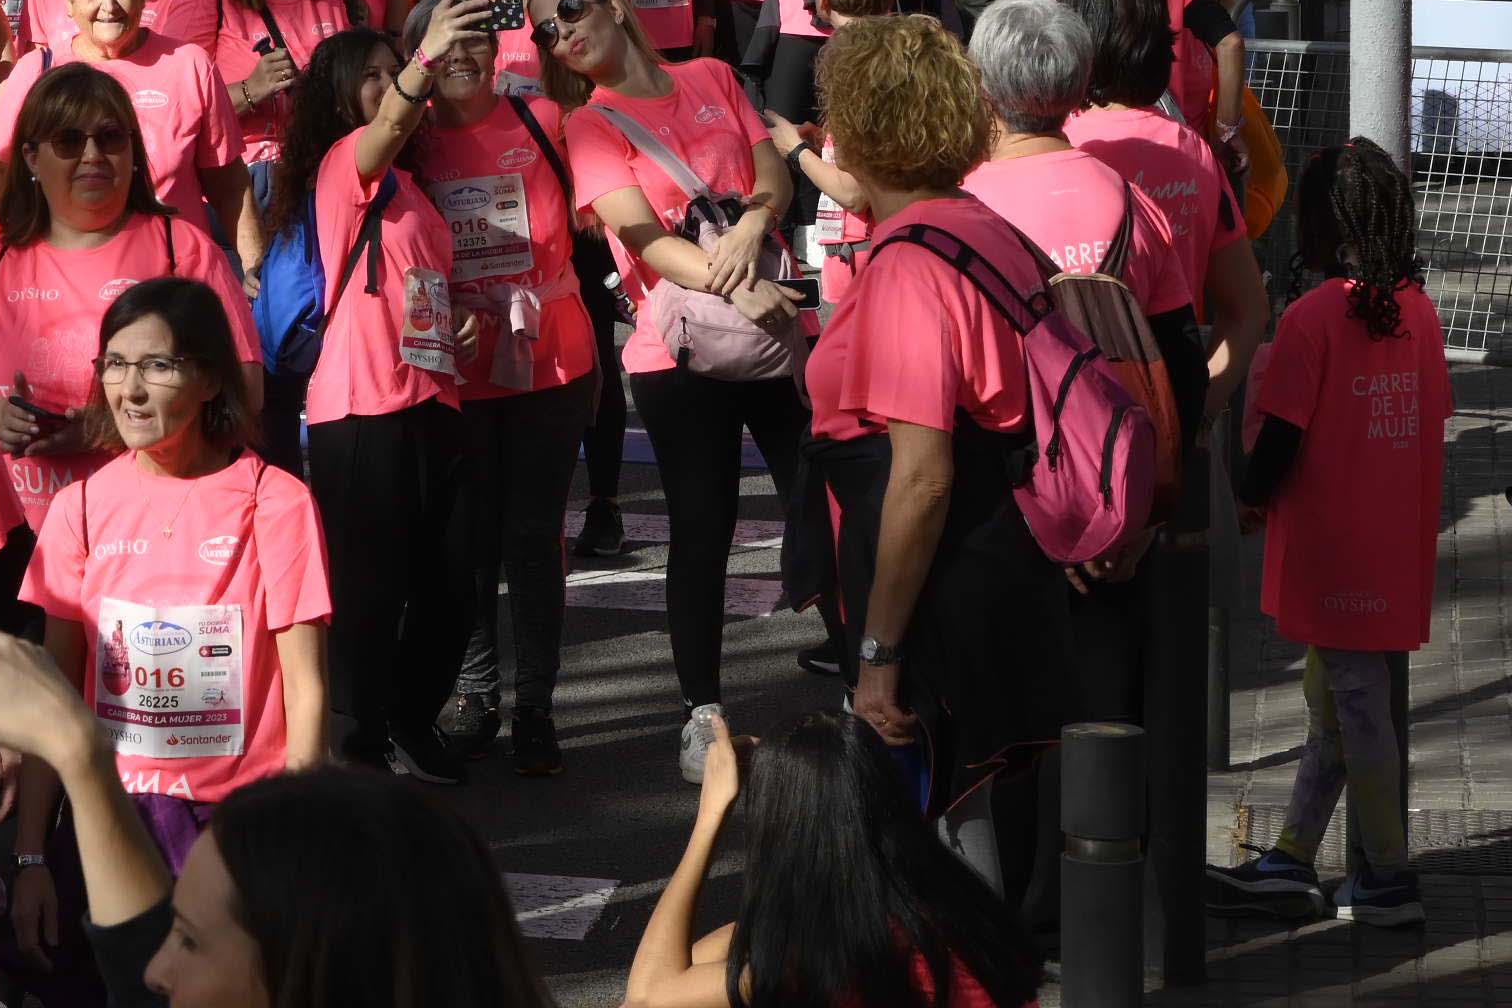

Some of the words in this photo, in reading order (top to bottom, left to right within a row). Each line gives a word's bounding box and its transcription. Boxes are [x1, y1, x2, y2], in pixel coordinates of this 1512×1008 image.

[451, 218, 489, 235] 016
[457, 236, 487, 248] 12375
[8, 288, 60, 303] OYSHO
[1371, 396, 1395, 416] DE
[1368, 416, 1418, 440] MUJE
[199, 626, 230, 635] SUMA
[134, 632, 187, 646] ASTURIANA
[134, 666, 185, 689] 016
[138, 694, 179, 709] 26225
[142, 714, 153, 723] DE
[155, 716, 166, 724] LA
[169, 714, 202, 724] MUJER
[205, 713, 228, 722] 2023
[180, 734, 232, 746] Santander
